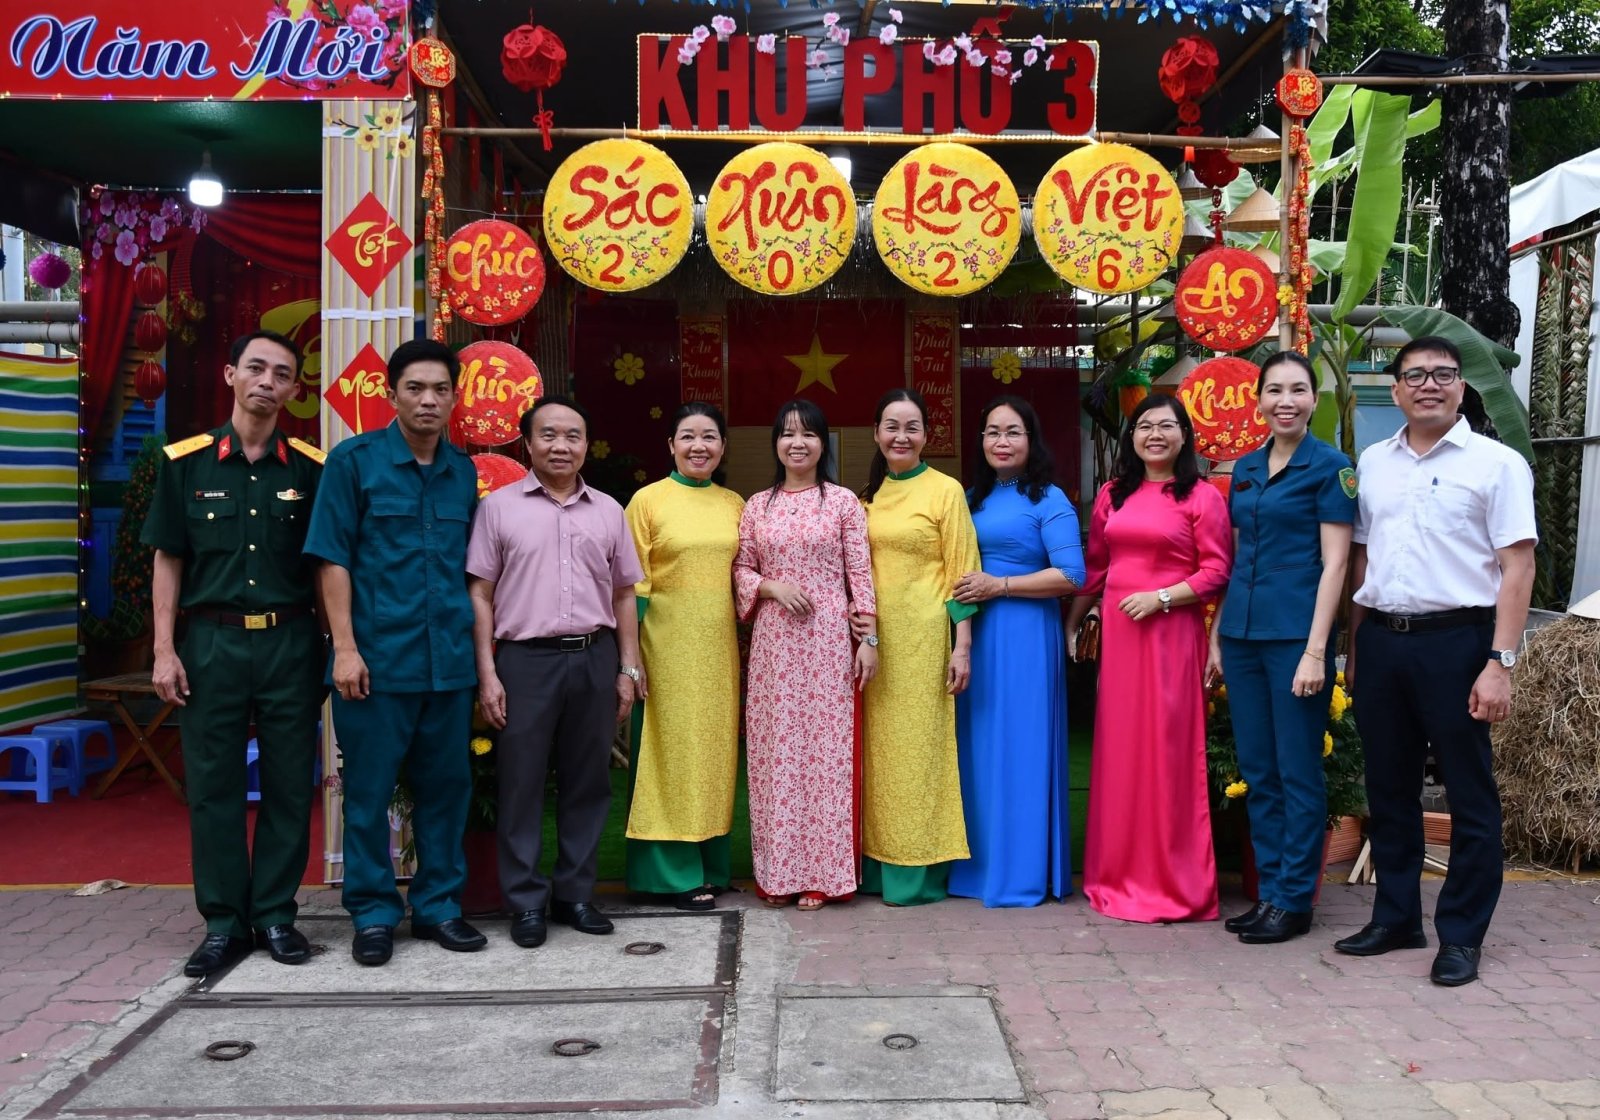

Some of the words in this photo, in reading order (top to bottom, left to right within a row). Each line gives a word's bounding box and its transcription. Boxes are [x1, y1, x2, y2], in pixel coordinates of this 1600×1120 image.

[10, 14, 217, 79] Năm
[229, 19, 391, 80] Mới
[639, 35, 807, 132] KHU
[843, 6, 1013, 136] PHỐ
[1047, 39, 1096, 136] 3
[563, 156, 682, 232] Sắc
[717, 161, 847, 251] Xuân
[882, 161, 1016, 237] Làng
[1051, 161, 1172, 232] Việt
[347, 221, 401, 268] Tết
[448, 231, 537, 291] Chúc
[1181, 261, 1265, 318] An
